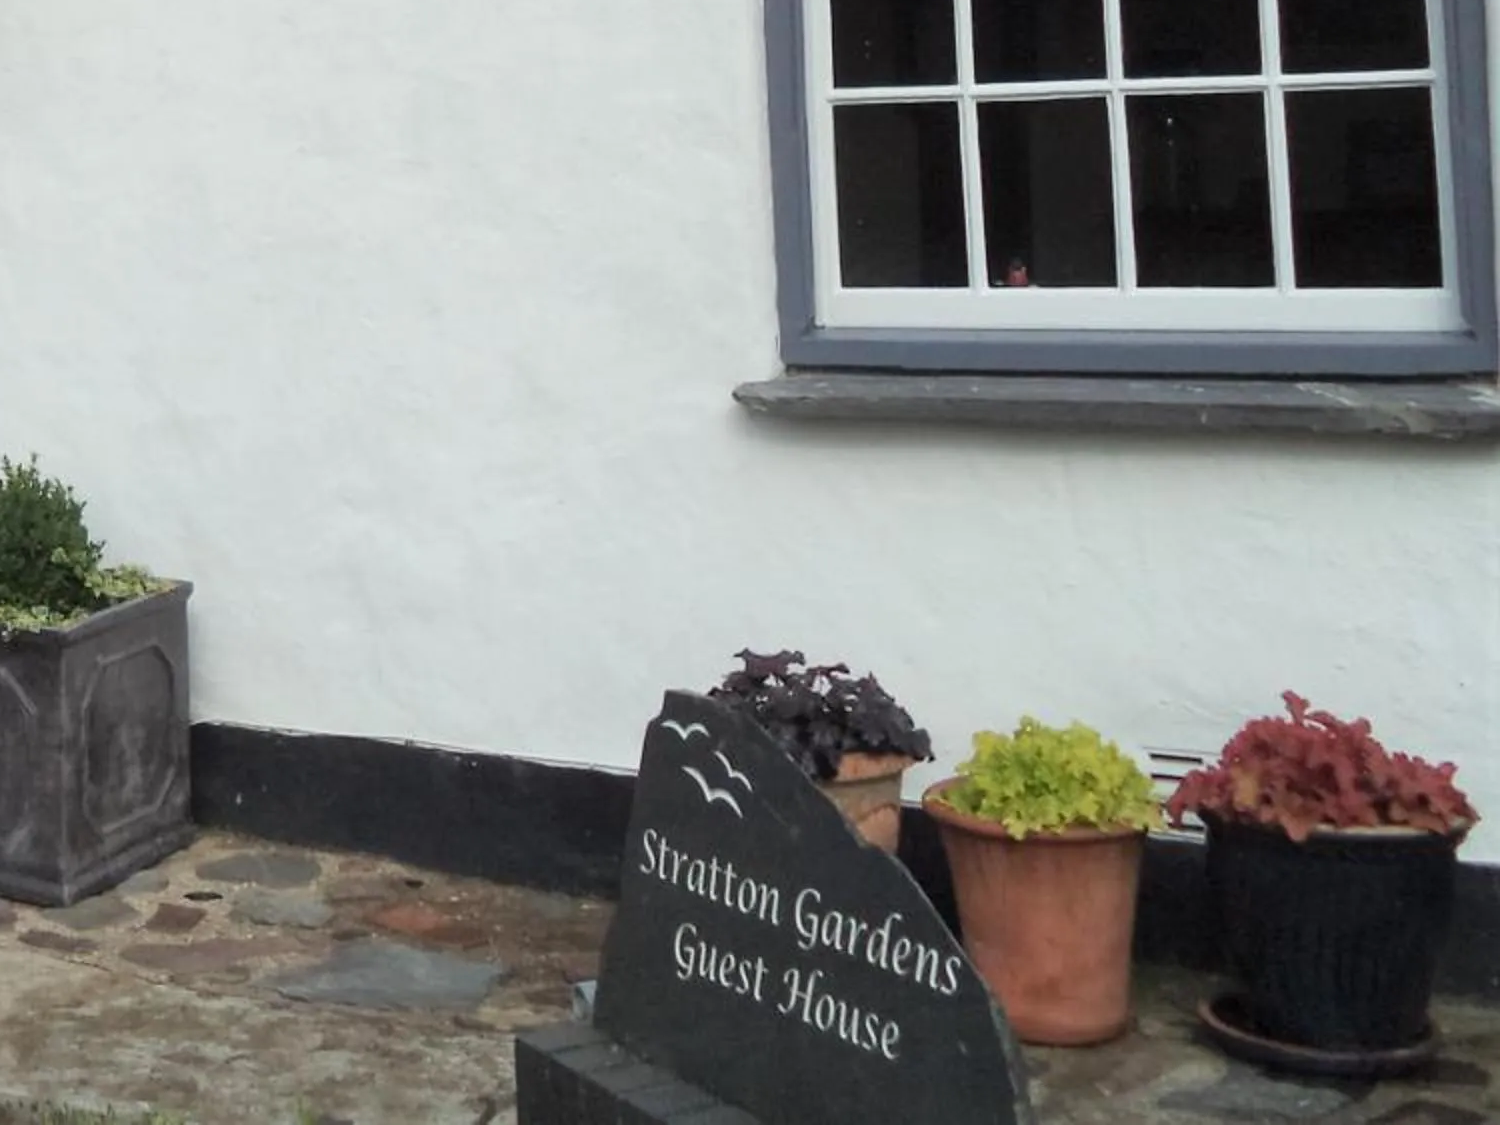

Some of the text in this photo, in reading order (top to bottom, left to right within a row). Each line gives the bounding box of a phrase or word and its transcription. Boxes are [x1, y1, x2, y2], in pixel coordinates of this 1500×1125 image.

[639, 828, 962, 996] Stratton Gardens
[673, 922, 901, 1060] Guest House
